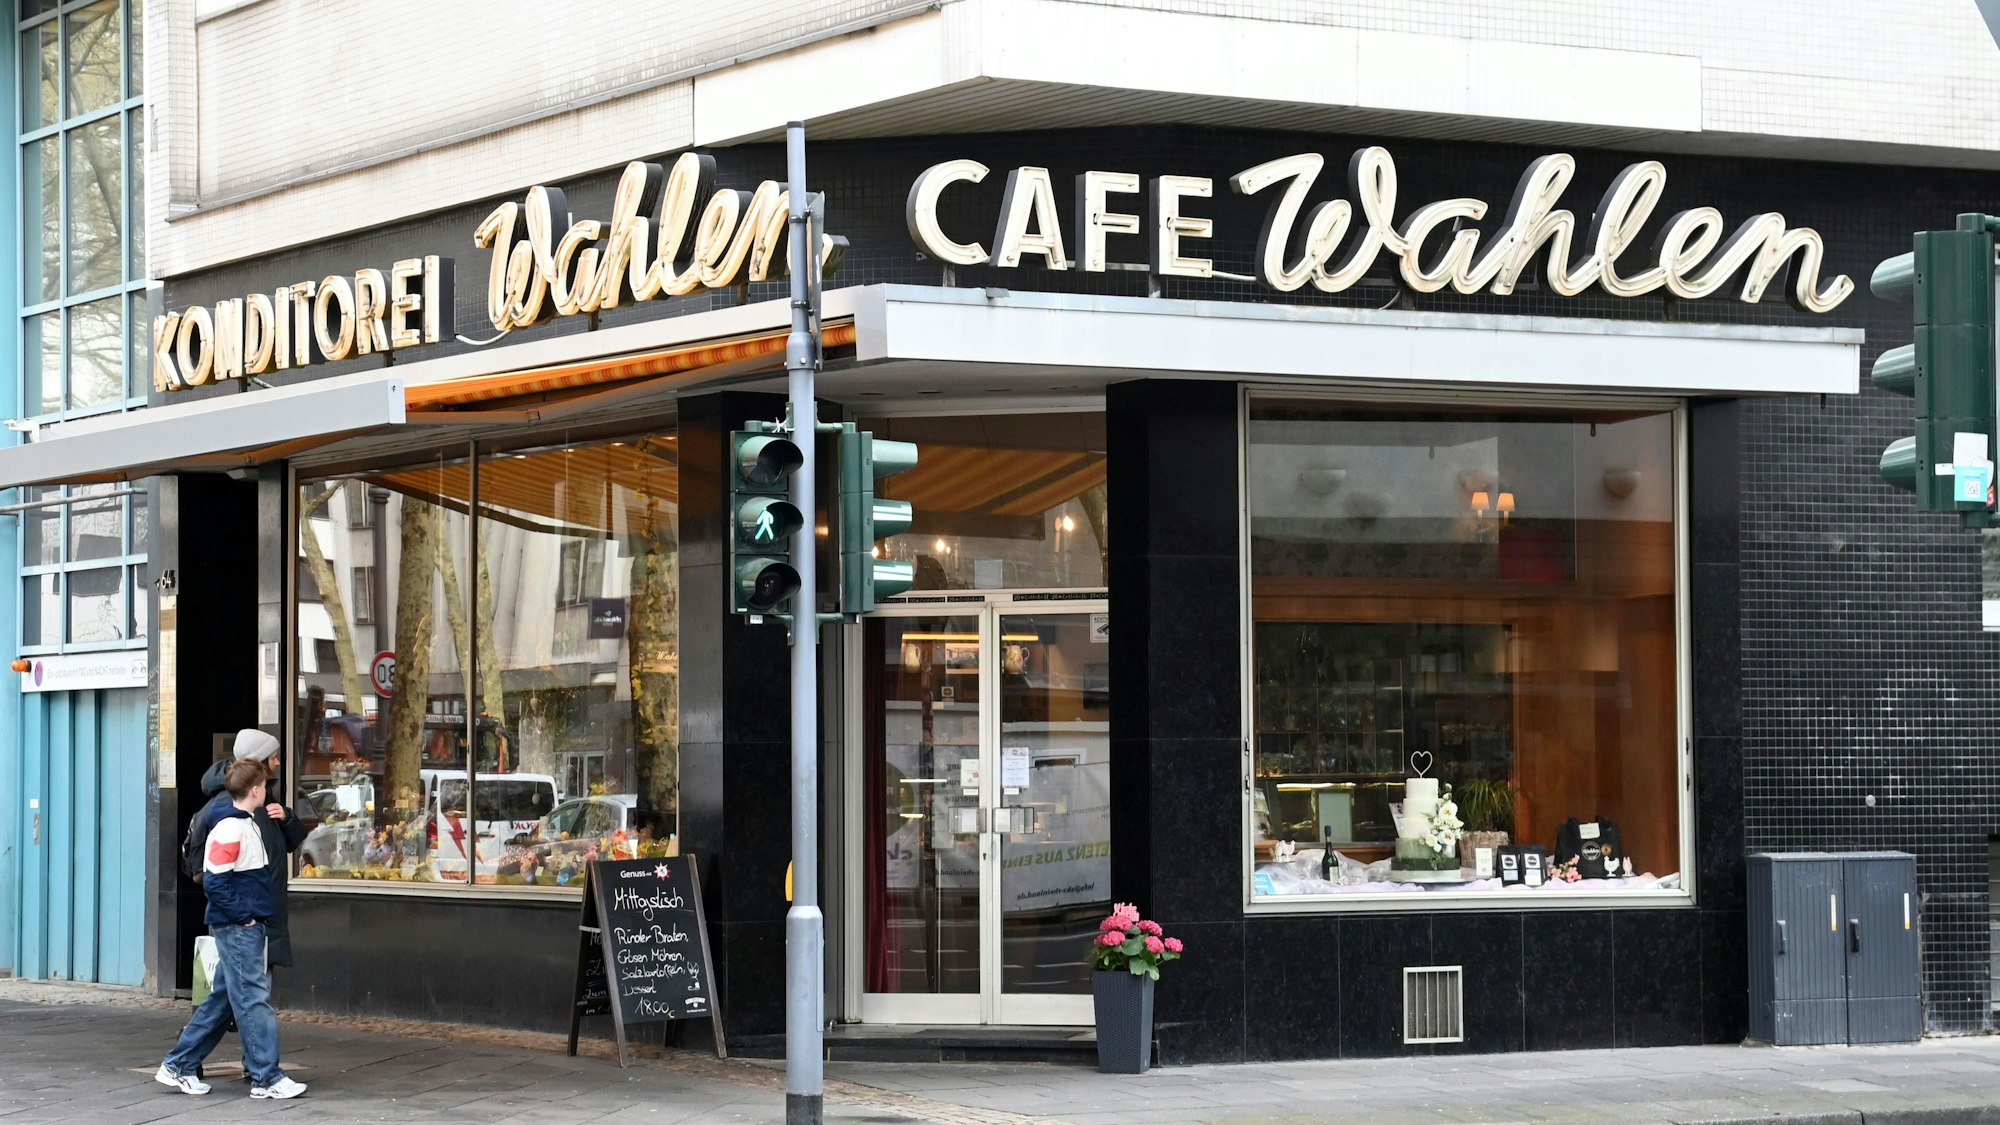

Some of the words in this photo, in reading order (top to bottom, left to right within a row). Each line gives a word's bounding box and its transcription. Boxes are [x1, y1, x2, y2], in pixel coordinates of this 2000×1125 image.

[906, 157, 1214, 278] CAFE
[1231, 145, 1855, 314] Wahlen
[153, 255, 452, 392] KONDITOREI
[161, 569, 172, 588] 64
[620, 870, 646, 879] Genuss
